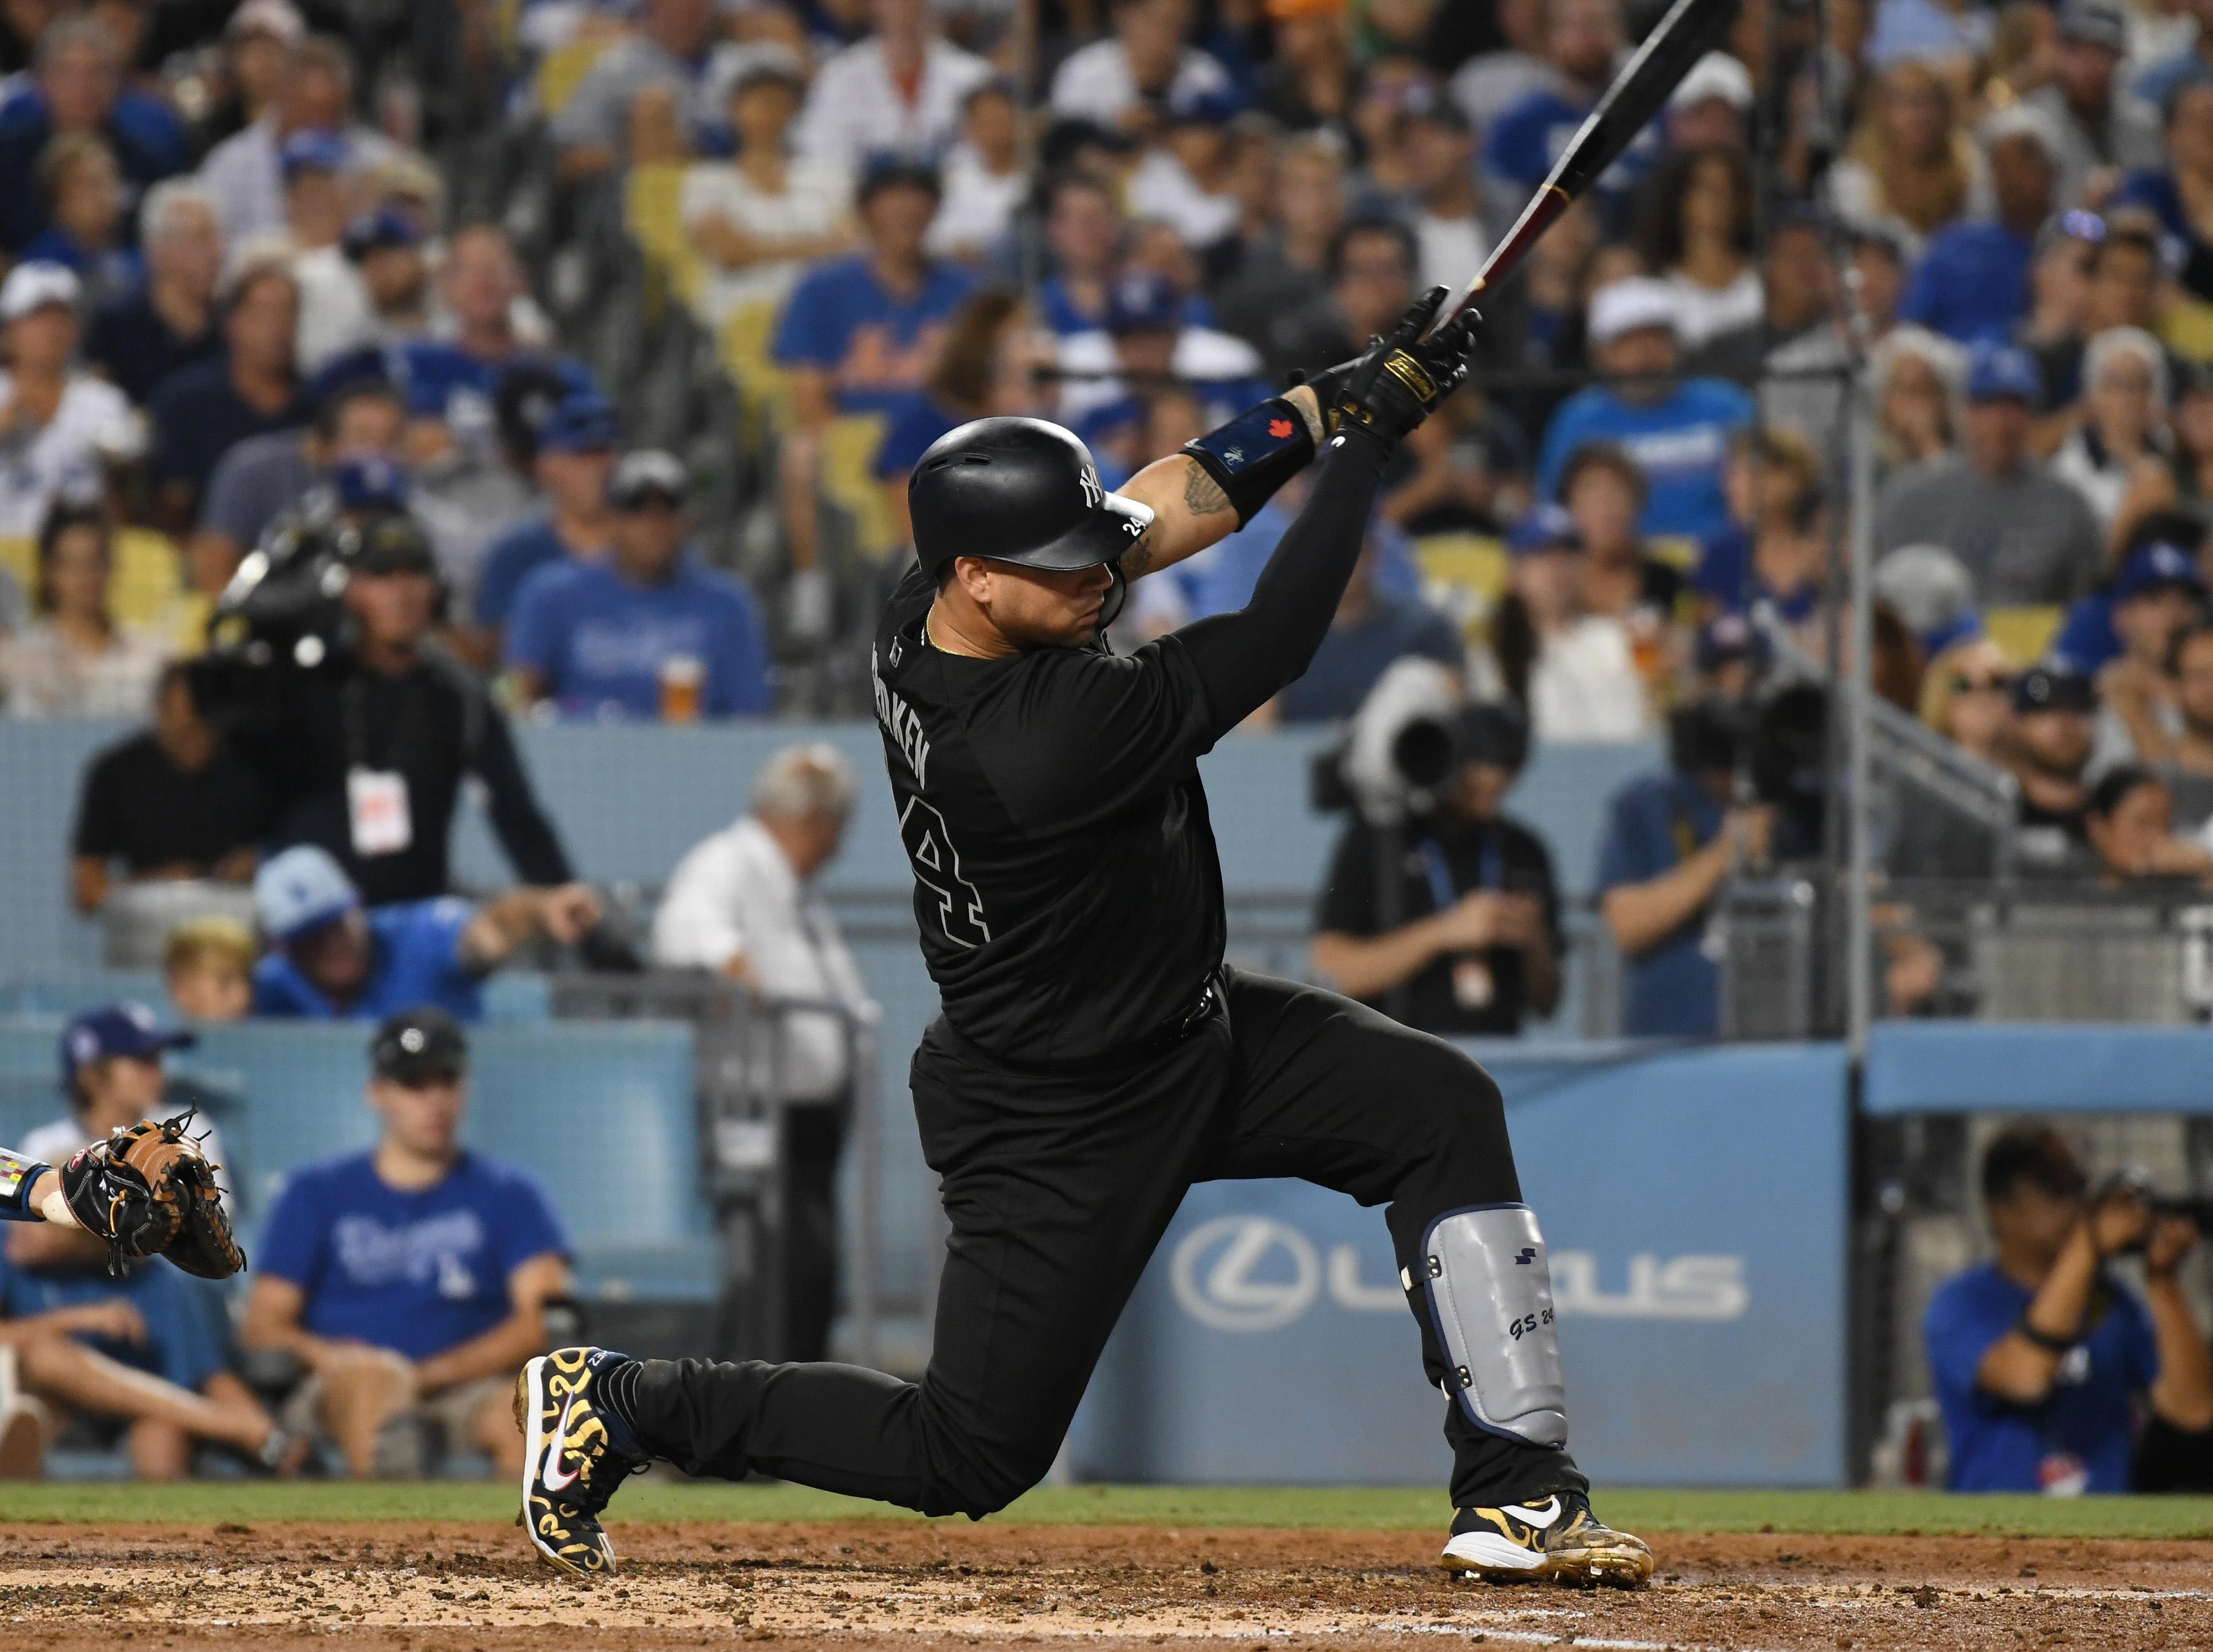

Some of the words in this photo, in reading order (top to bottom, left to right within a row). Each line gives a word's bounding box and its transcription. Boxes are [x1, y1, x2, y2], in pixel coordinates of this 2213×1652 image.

[1122, 516, 1147, 537] 24
[1509, 1313, 1537, 1341] GS
[1541, 1307, 1554, 1325] 24
